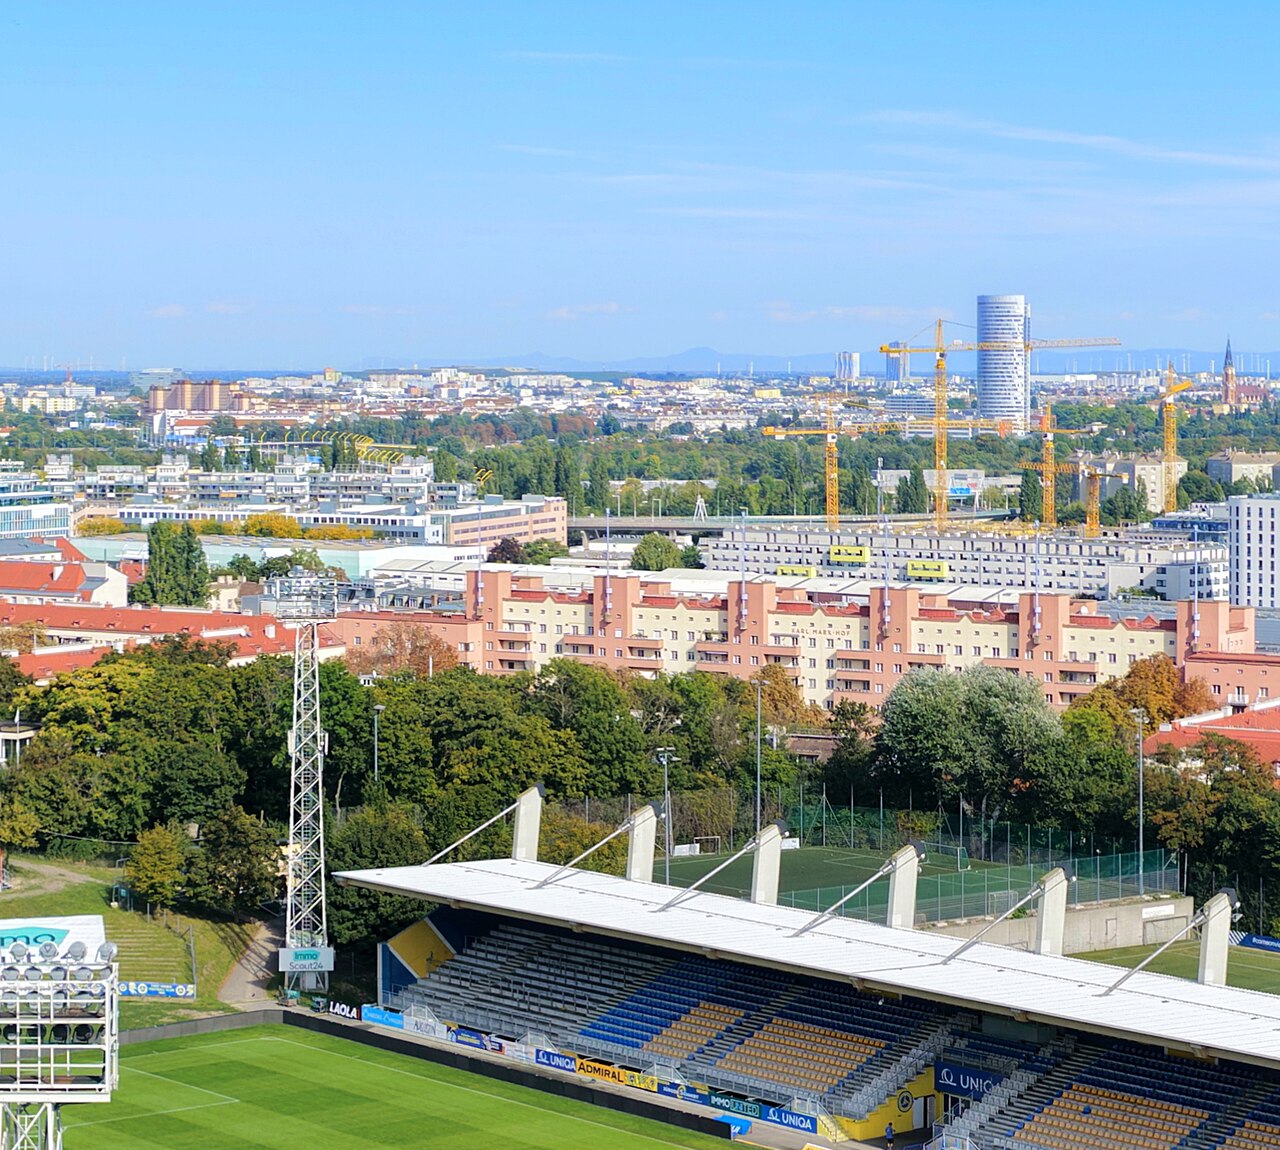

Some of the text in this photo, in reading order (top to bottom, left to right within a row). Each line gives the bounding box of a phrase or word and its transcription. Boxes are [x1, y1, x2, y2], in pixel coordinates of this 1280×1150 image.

[293, 951, 319, 961] Immo
[289, 961, 324, 970] Scout24
[550, 1055, 577, 1072] UNIQA
[577, 1060, 625, 1084] ADMIRAL
[960, 1073, 999, 1095] UNIQ
[781, 1111, 813, 1130] UNIQA
